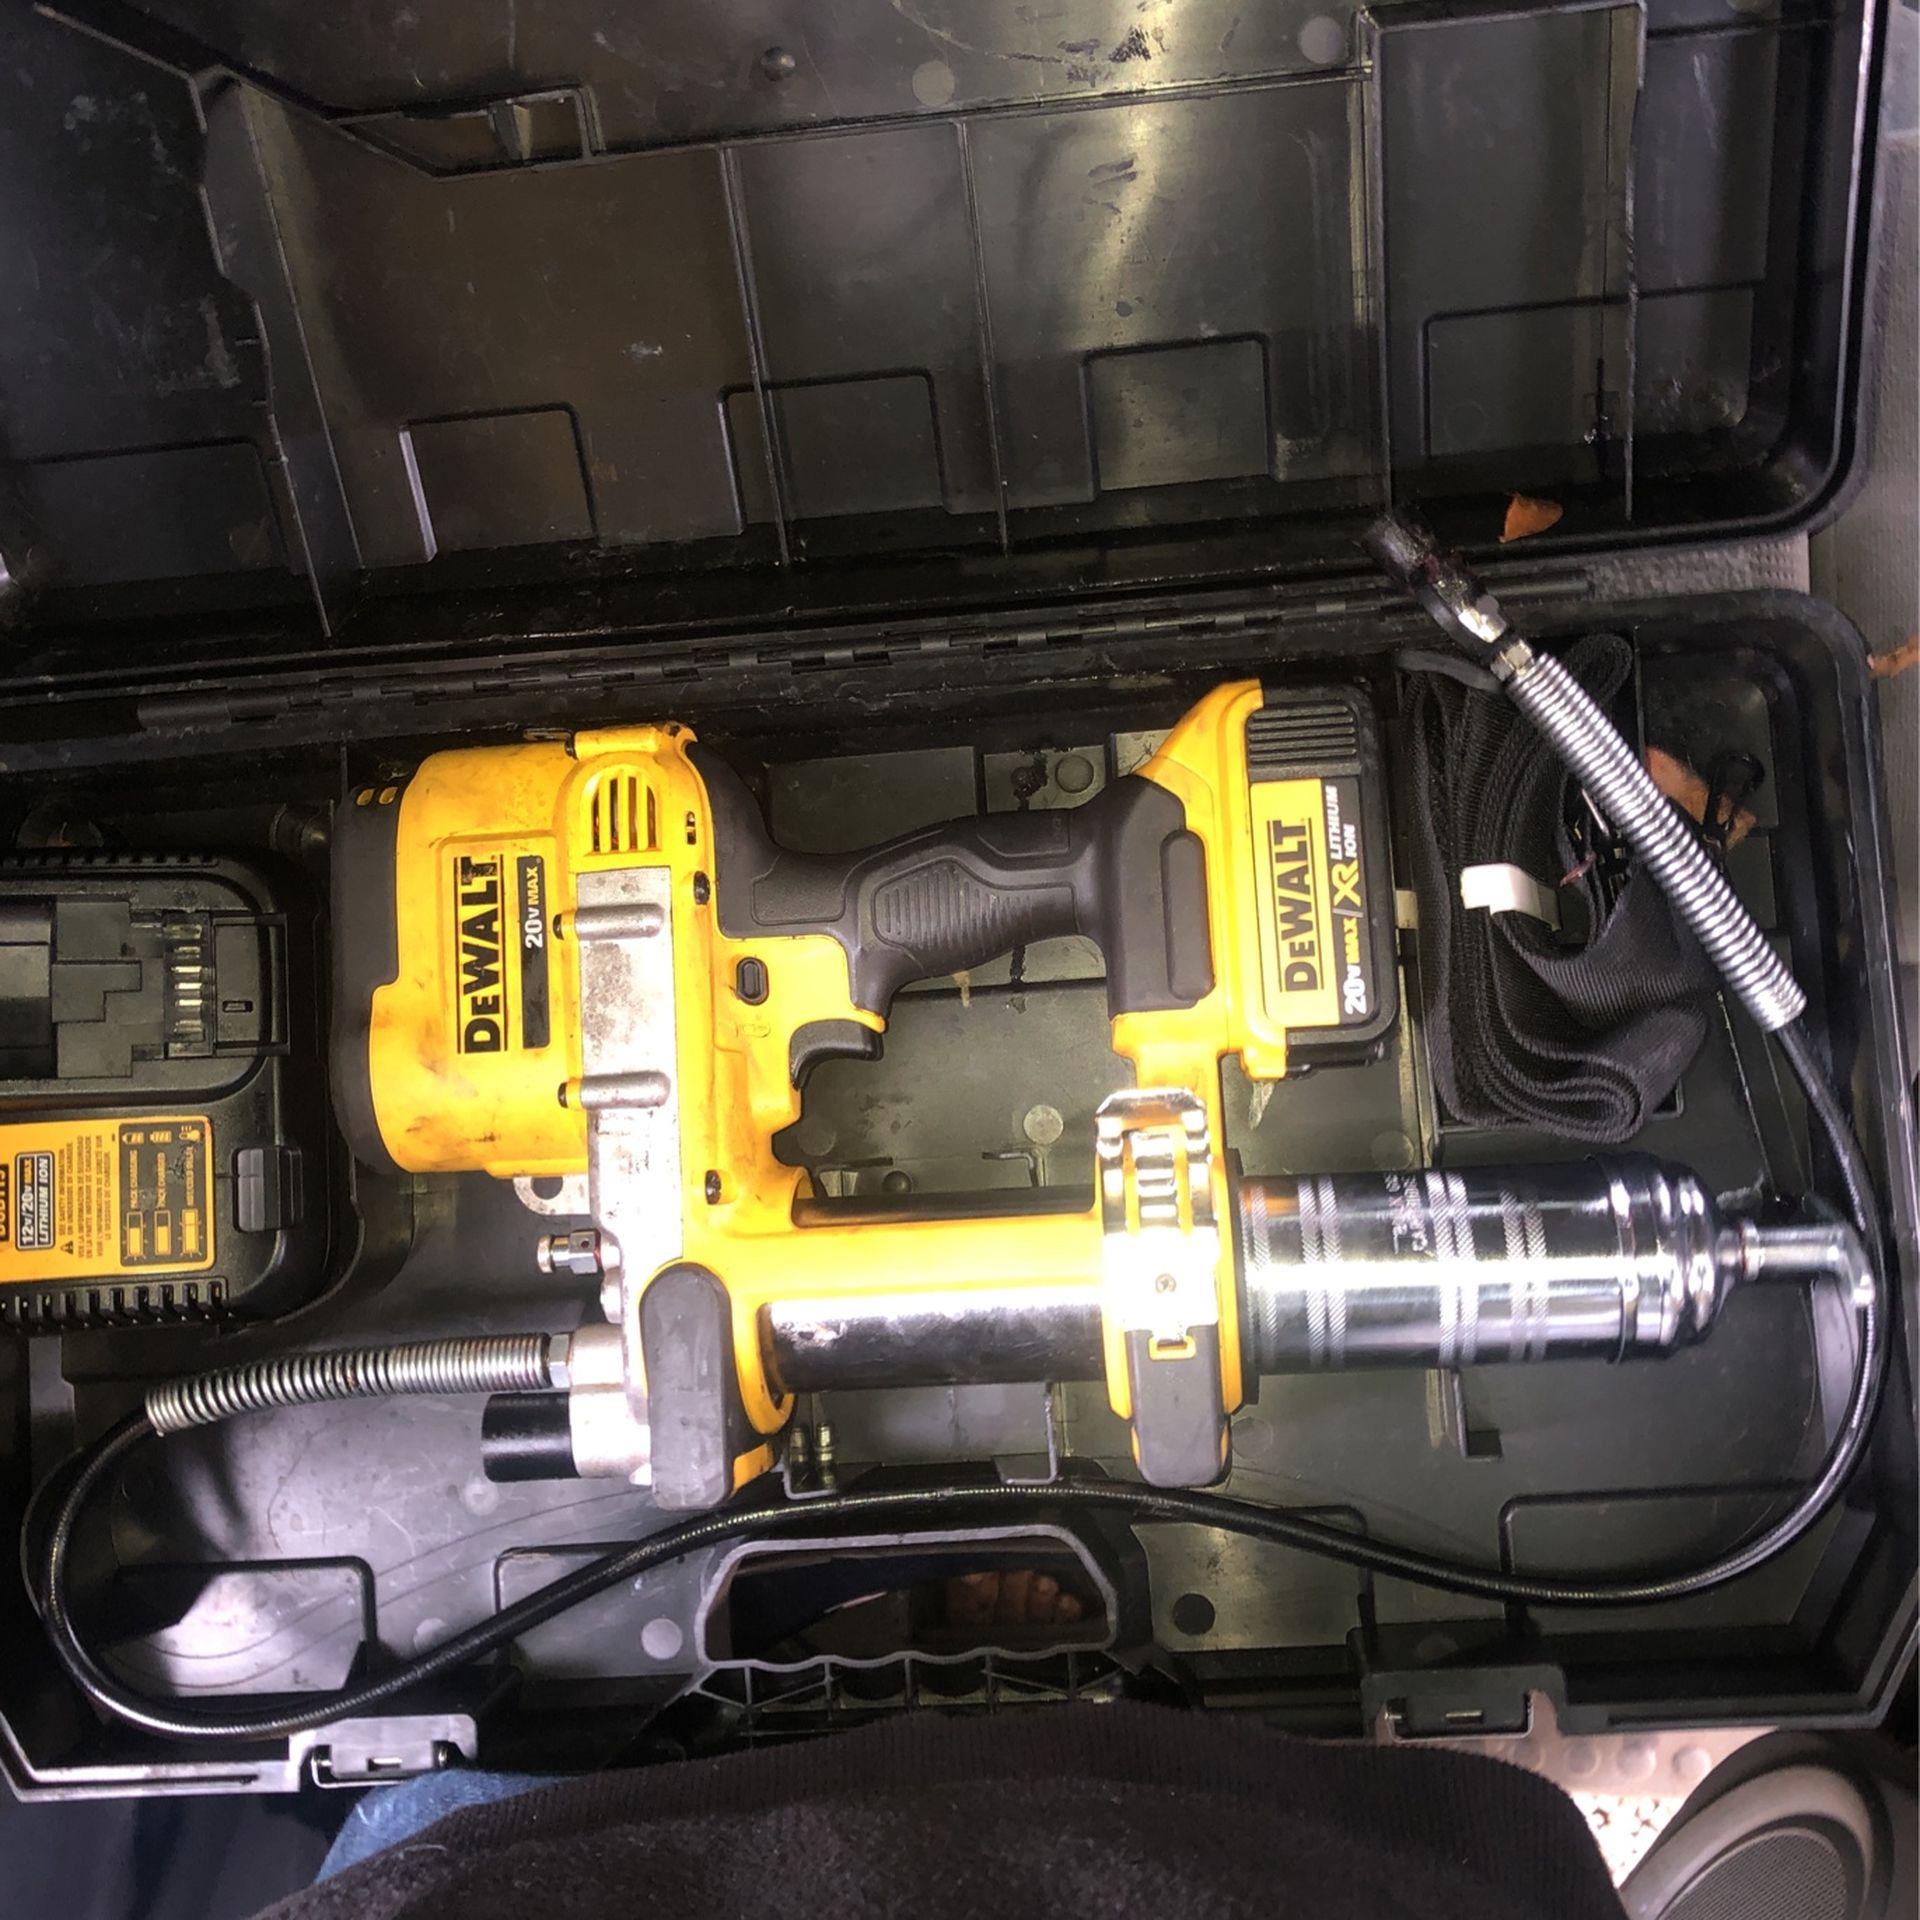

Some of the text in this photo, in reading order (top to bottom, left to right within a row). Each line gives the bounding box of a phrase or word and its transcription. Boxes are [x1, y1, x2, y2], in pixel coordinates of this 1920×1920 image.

[1325, 785, 1343, 860] LITHIUM
[1343, 824, 1358, 858] ION
[526, 866, 539, 905] MAX
[1273, 820, 1318, 991] DEWALT
[1331, 860, 1361, 907] XR
[461, 856, 501, 1054] DEWALT
[1342, 918, 1360, 963] MAX
[157, 1152, 165, 1187] CHARGED
[39, 1158, 48, 1243] LITHIUM ION
[130, 1189, 138, 1209] PACK
